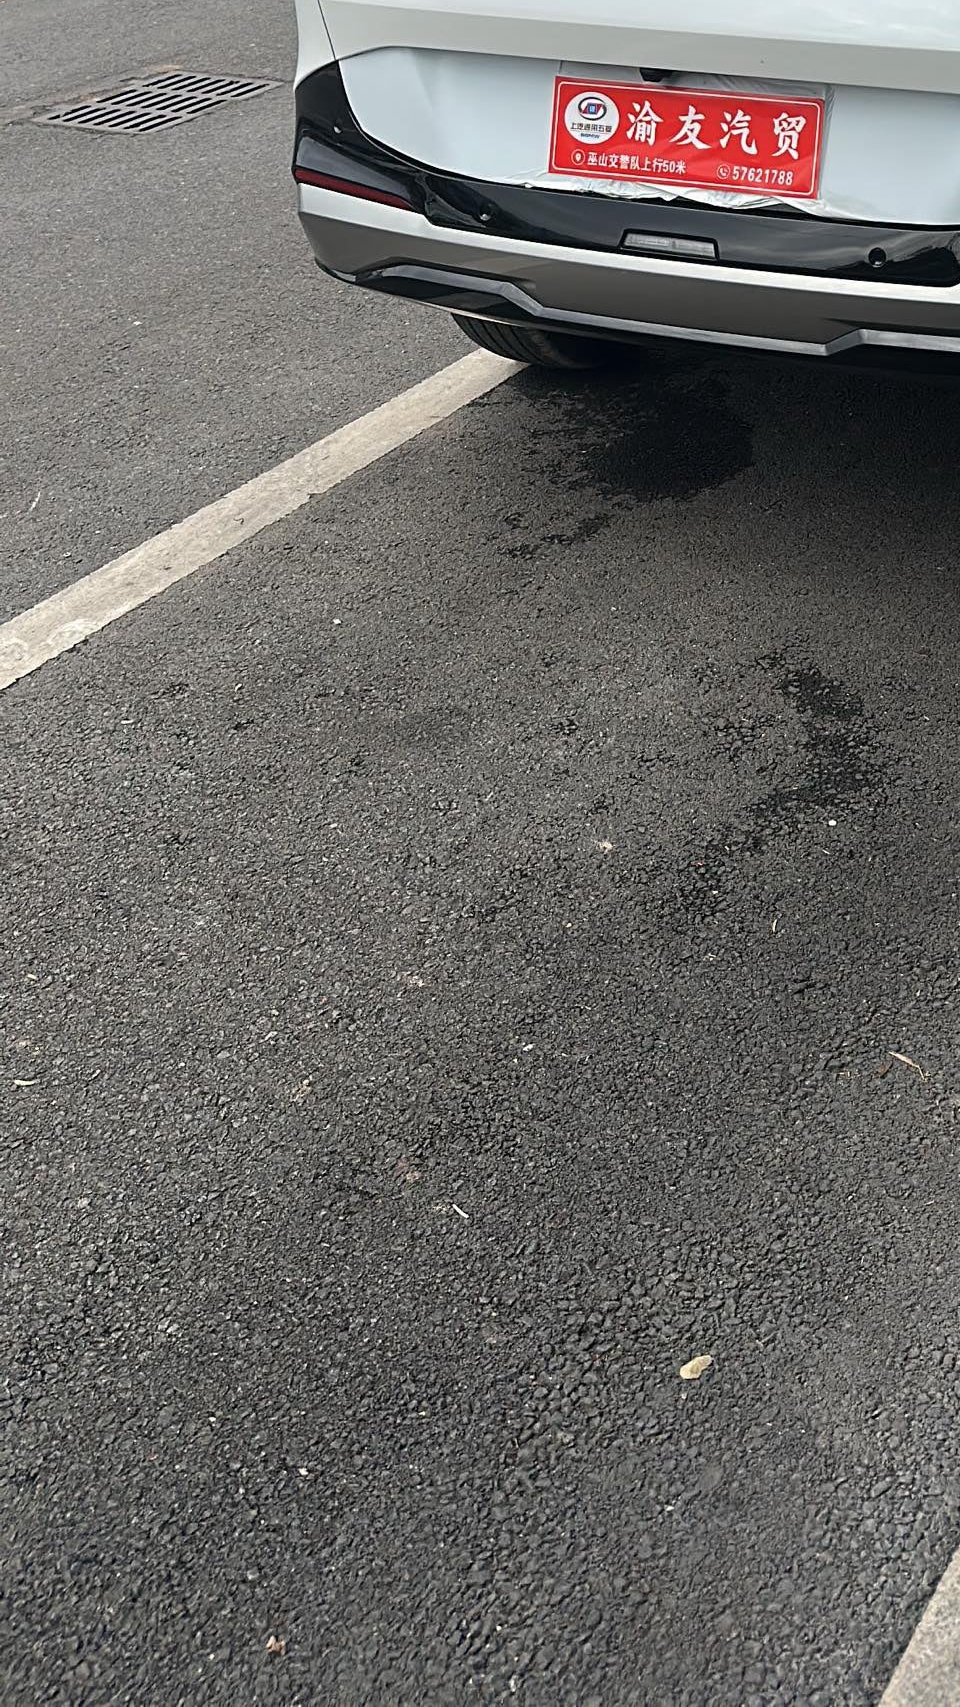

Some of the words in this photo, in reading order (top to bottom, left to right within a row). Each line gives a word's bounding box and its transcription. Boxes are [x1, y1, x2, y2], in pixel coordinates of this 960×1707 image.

[625, 100, 808, 160] 渝友汽贸
[587, 151, 687, 176] 巫山交警队上行50米
[732, 167, 794, 186] 57621788
